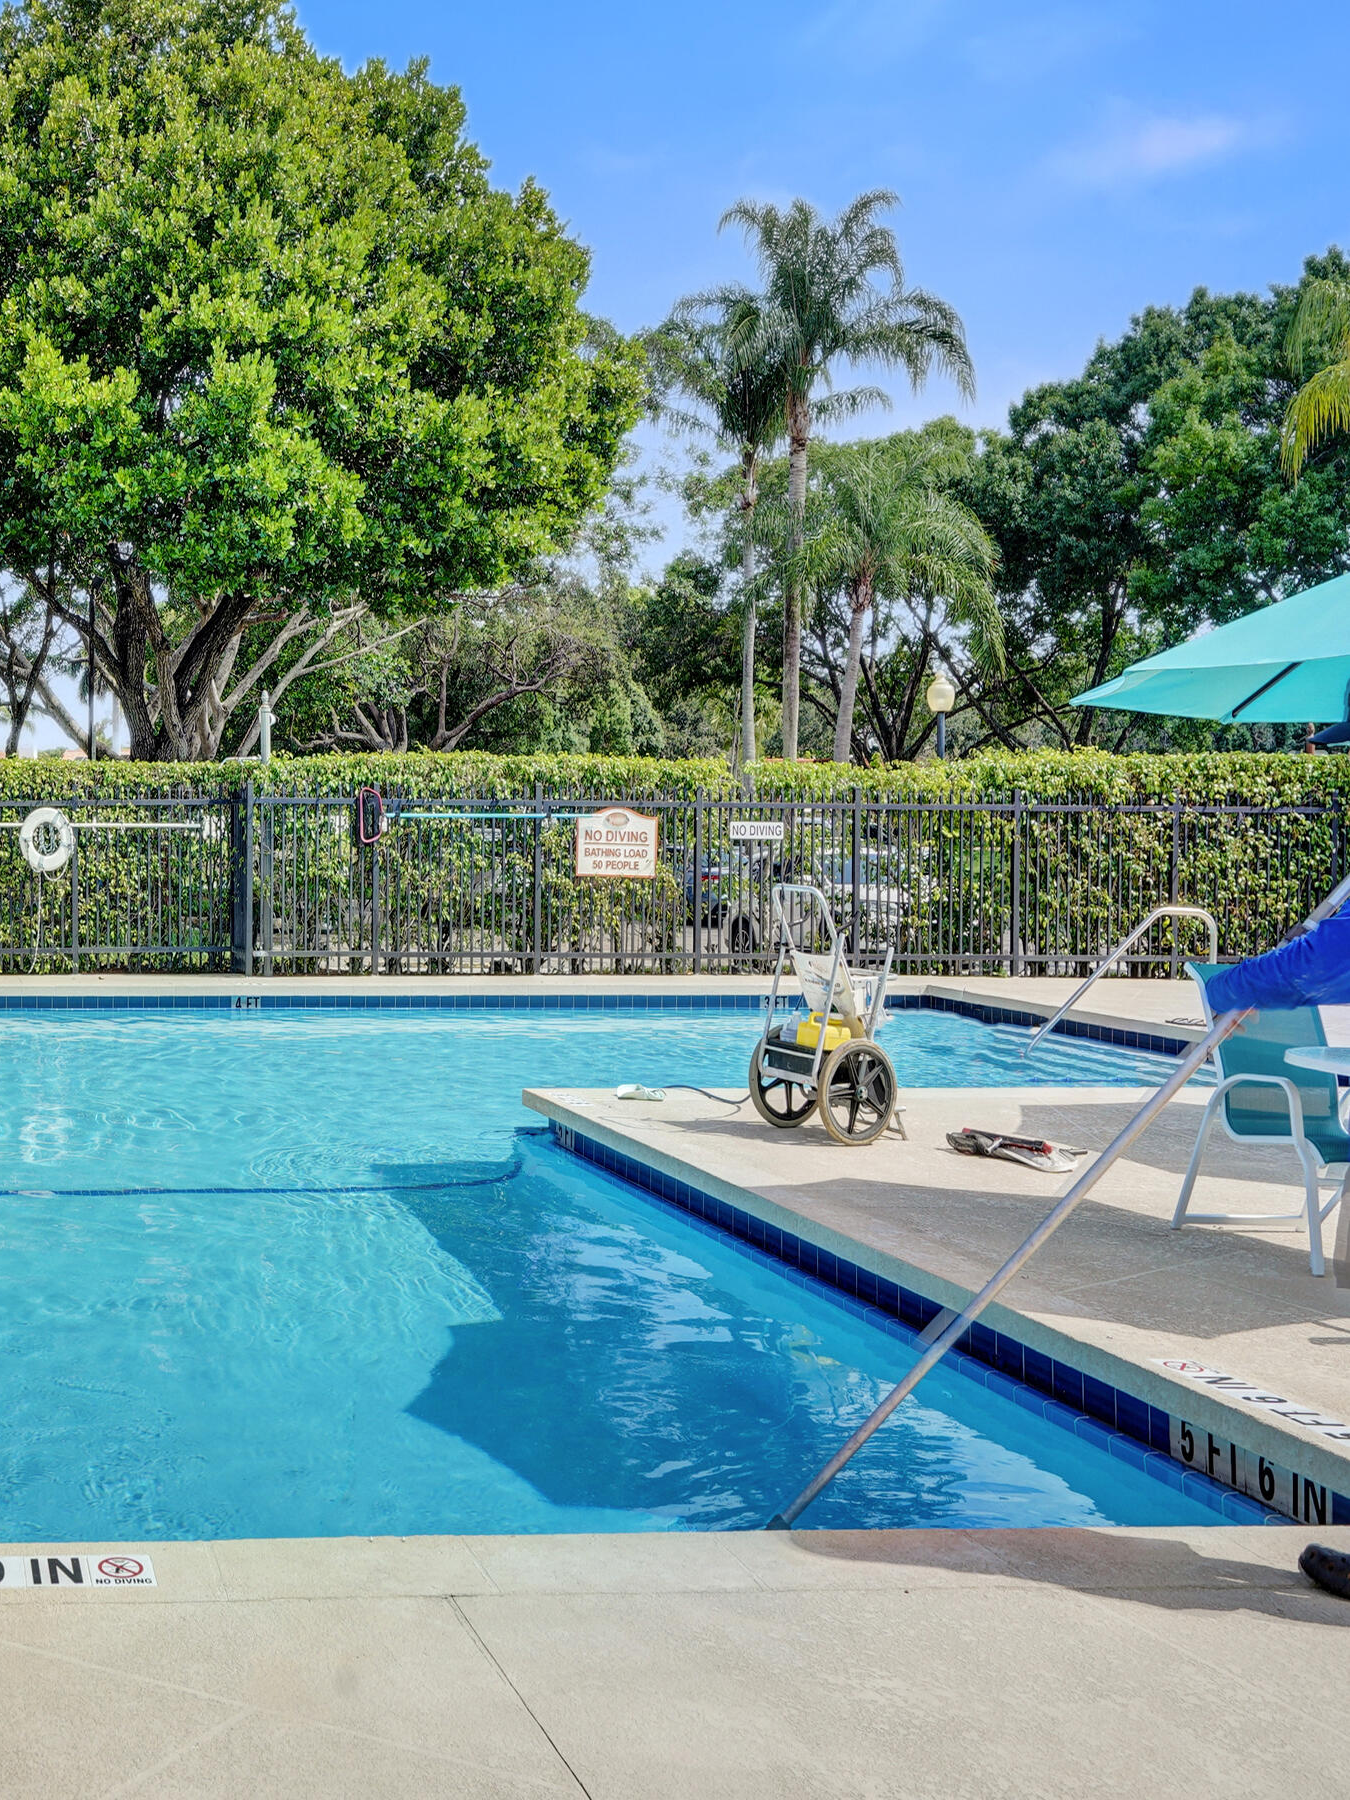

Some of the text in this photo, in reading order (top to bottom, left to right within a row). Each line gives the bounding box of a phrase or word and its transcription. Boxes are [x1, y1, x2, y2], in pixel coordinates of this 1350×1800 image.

[584, 829, 648, 842] NO DIVING
[732, 824, 782, 836] NO DIVING
[584, 847, 648, 858] BATHING LOAD
[593, 860, 639, 870] 50 PEOPLE
[235, 996, 260, 1008] 4 FT
[764, 995, 787, 1008] 3 FT
[1193, 1376, 1258, 1390] IN
[1269, 1408, 1346, 1426] FT
[1181, 1420, 1194, 1463] 5
[1259, 1456, 1275, 1502] 6
[1293, 1472, 1327, 1526] IN
[30, 1557, 84, 1584] IN
